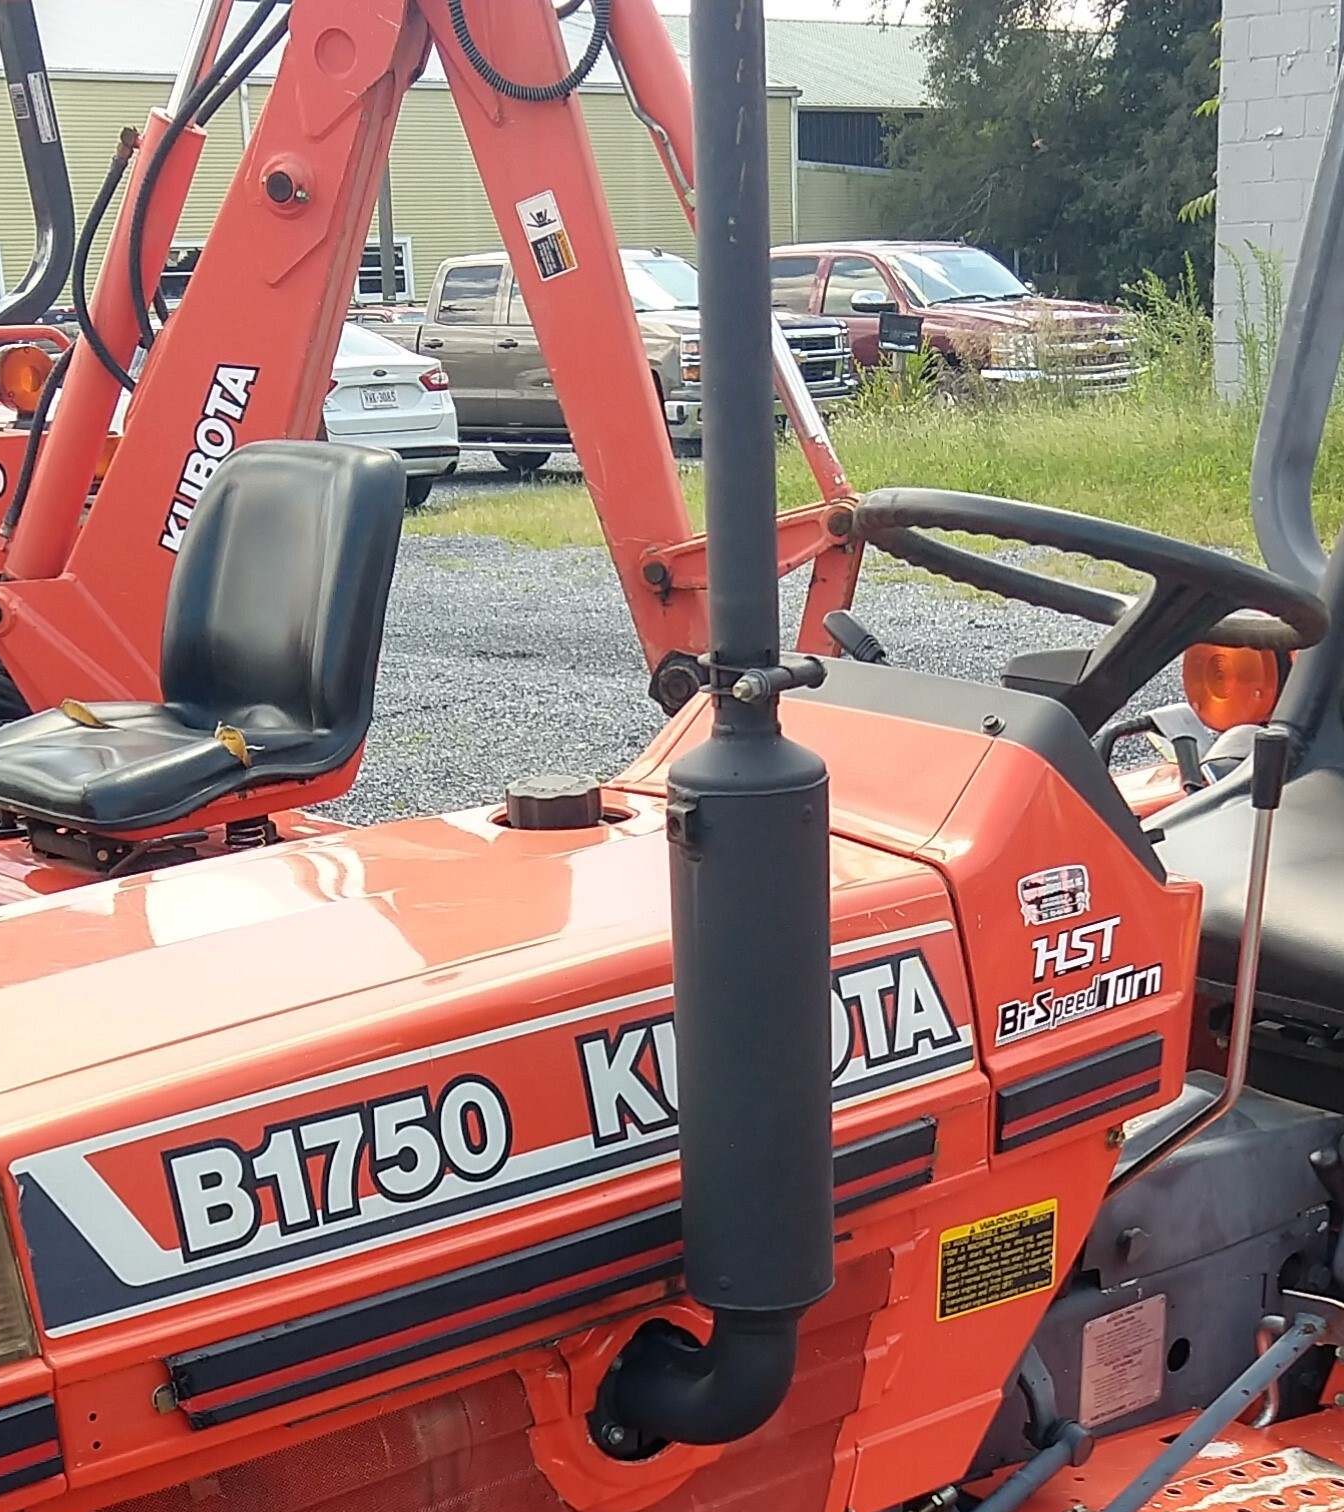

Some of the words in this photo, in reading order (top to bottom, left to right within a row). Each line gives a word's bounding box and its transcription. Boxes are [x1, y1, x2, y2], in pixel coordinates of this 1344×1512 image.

[158, 363, 260, 554] KUBOTA
[1031, 914, 1122, 984] HST
[997, 973, 1101, 1039] Bi-Speed
[1099, 963, 1163, 1010] Turn
[162, 1072, 513, 1265] B1750
[577, 950, 962, 1150] KTA
[979, 1210, 1029, 1231] WARNING
